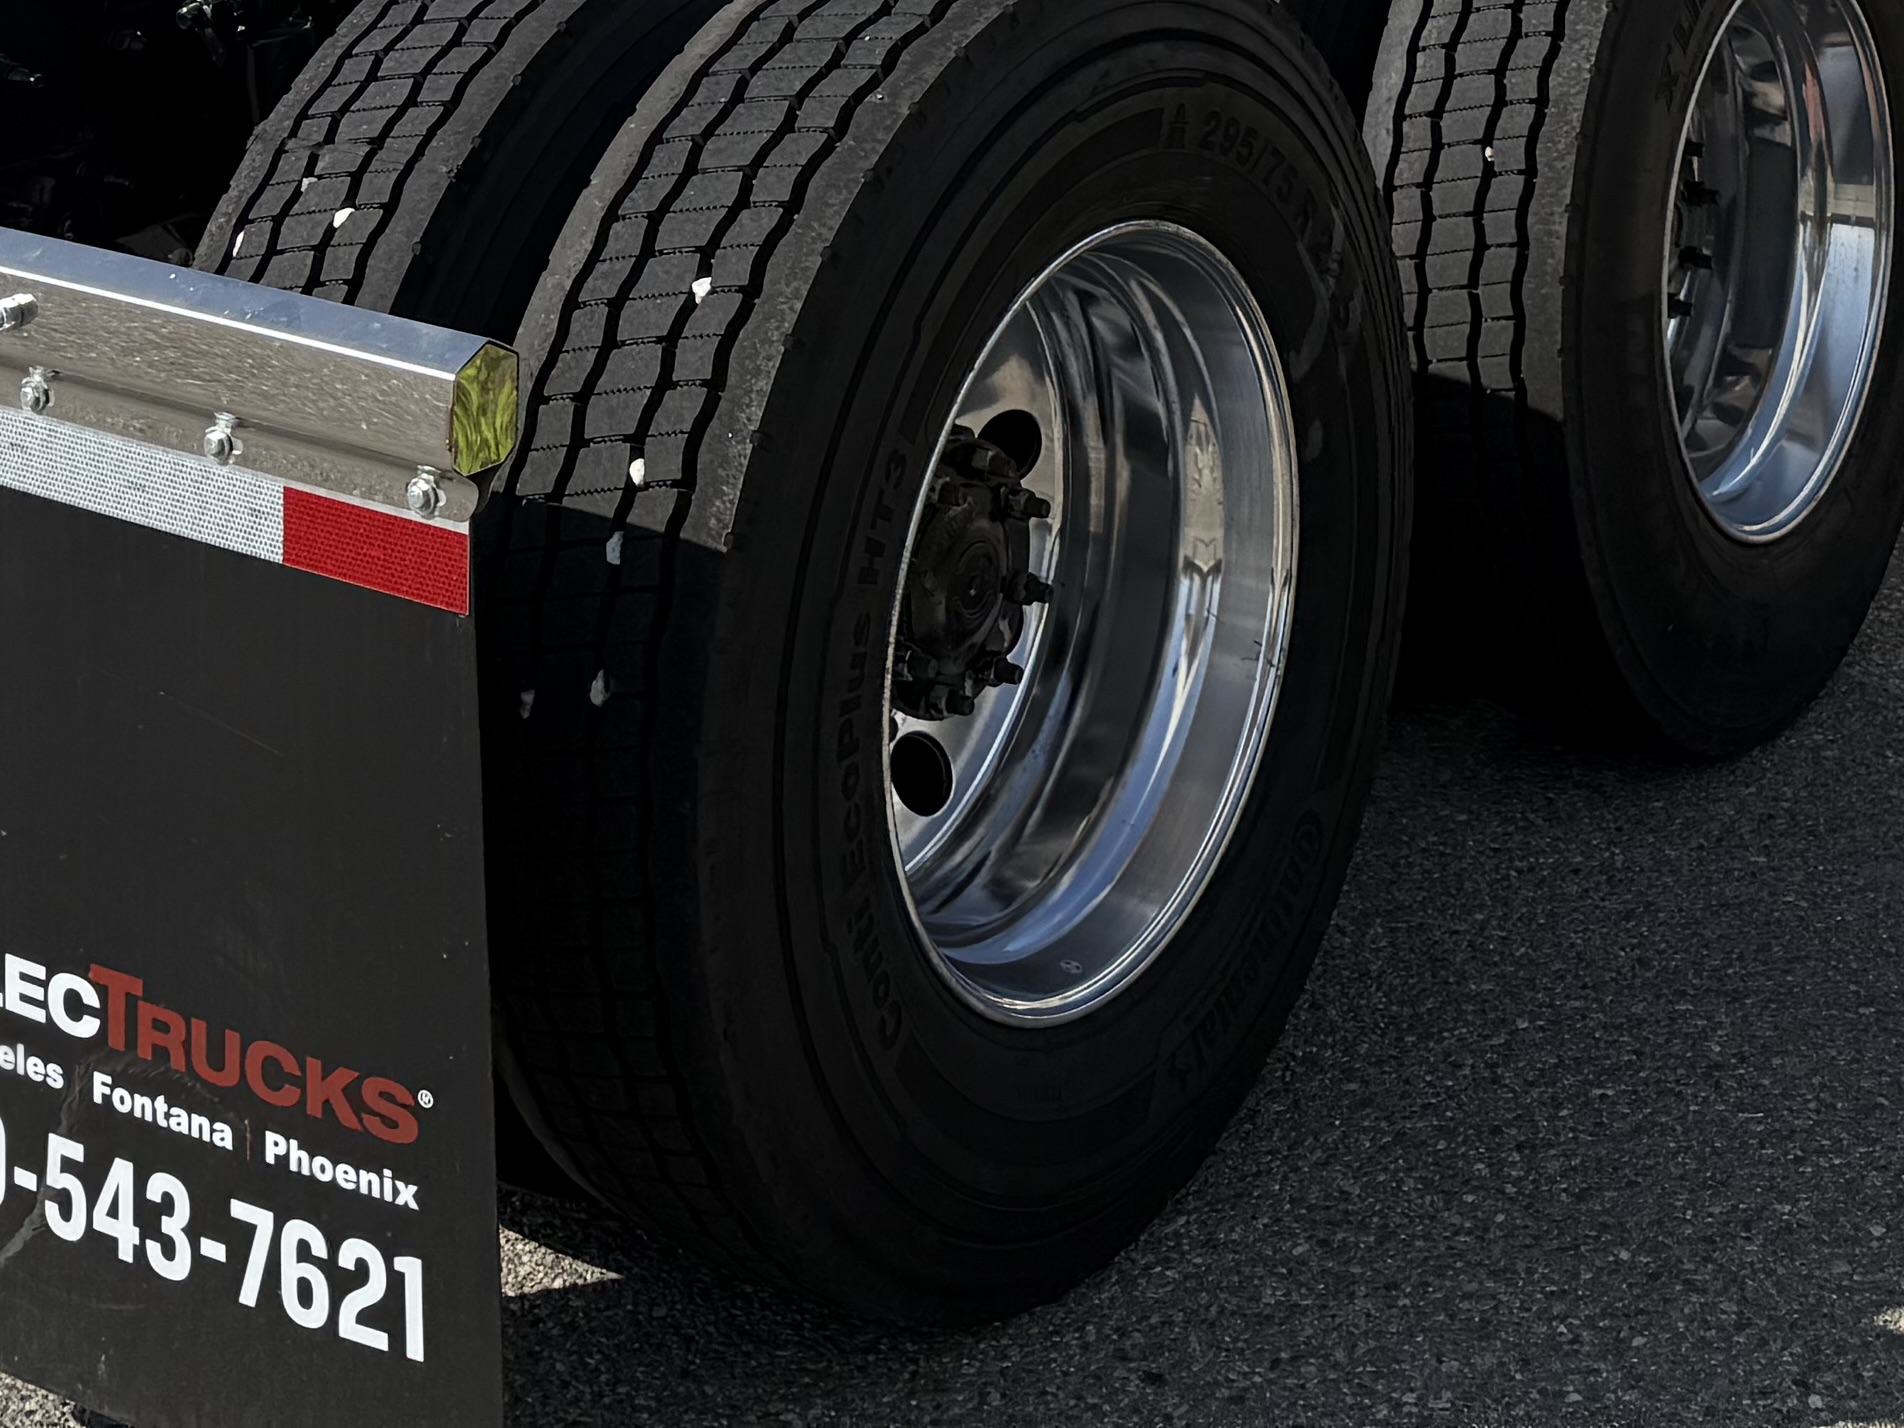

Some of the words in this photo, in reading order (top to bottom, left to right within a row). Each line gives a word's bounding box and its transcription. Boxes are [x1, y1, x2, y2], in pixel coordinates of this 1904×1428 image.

[1199, 109, 1299, 204] 295/75
[856, 445, 910, 589] HT3
[92, 1070, 234, 1151] Fontana
[264, 1130, 421, 1212] Phoenix
